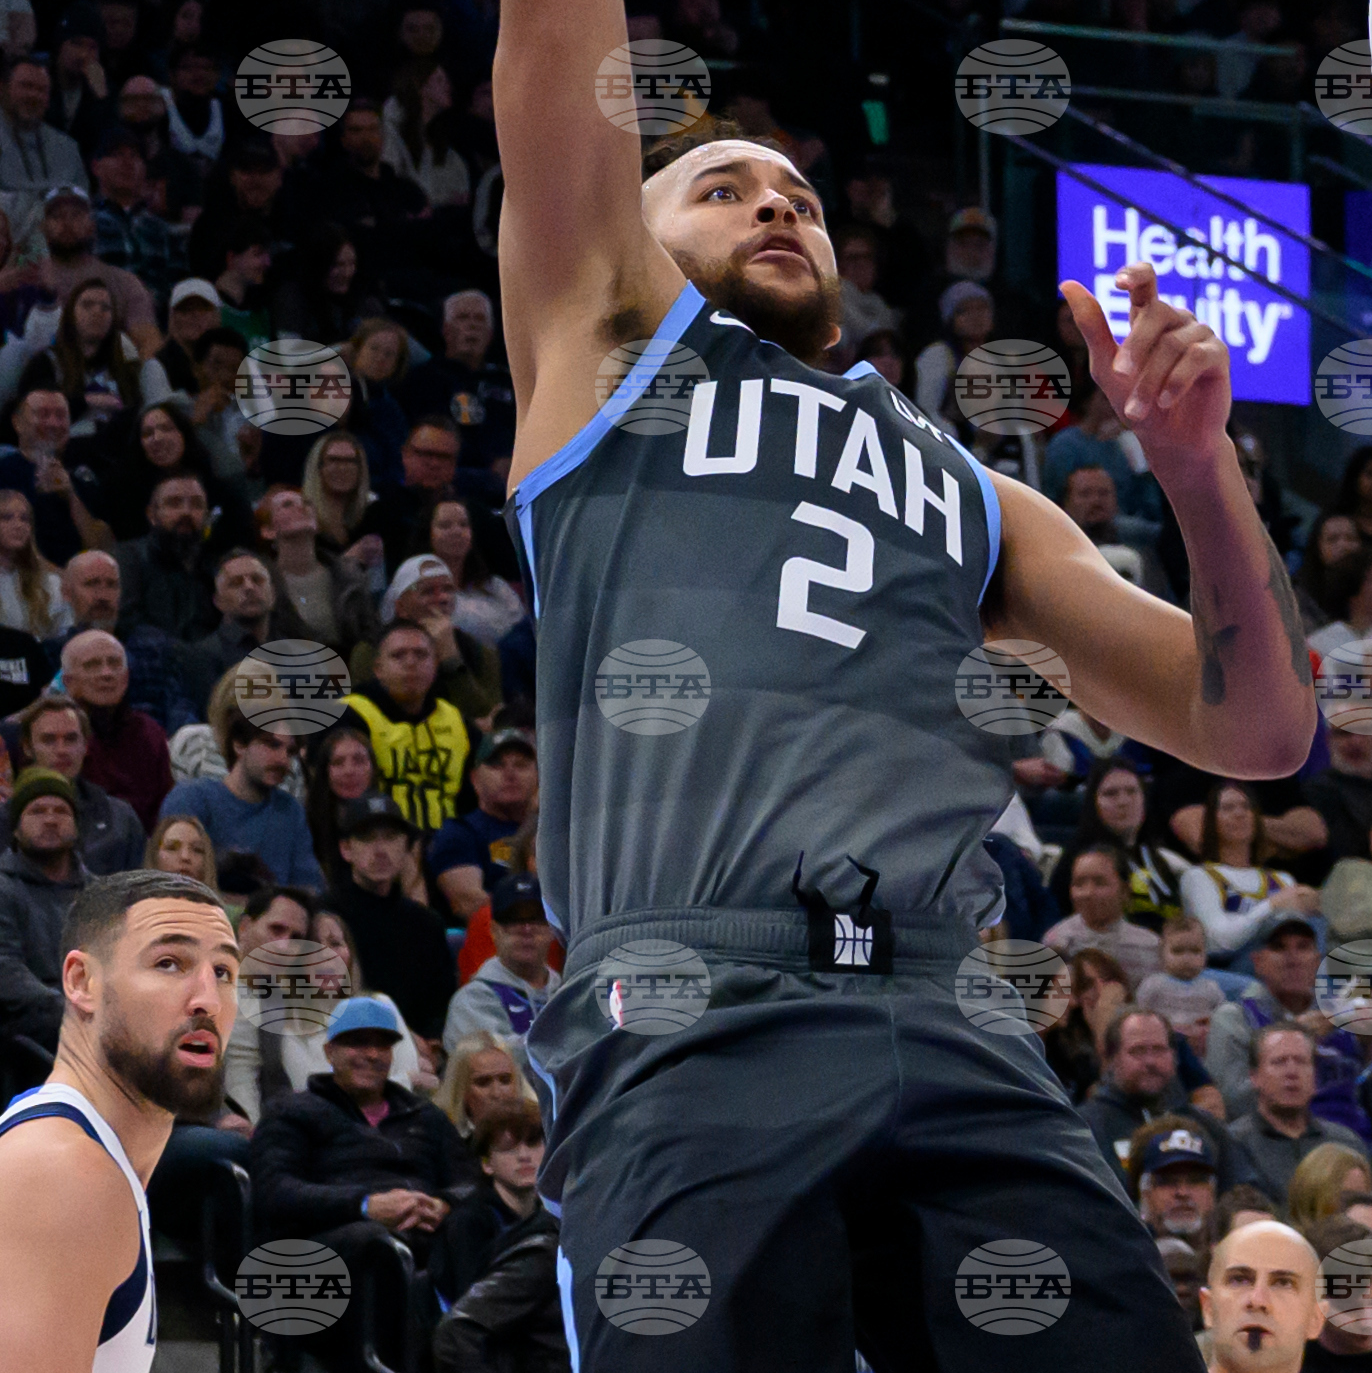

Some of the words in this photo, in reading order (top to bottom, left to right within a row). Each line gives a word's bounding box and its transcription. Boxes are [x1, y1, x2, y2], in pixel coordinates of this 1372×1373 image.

[1093, 205, 1281, 284] Health
[682, 379, 964, 567] UTAH
[776, 500, 874, 649] 2
